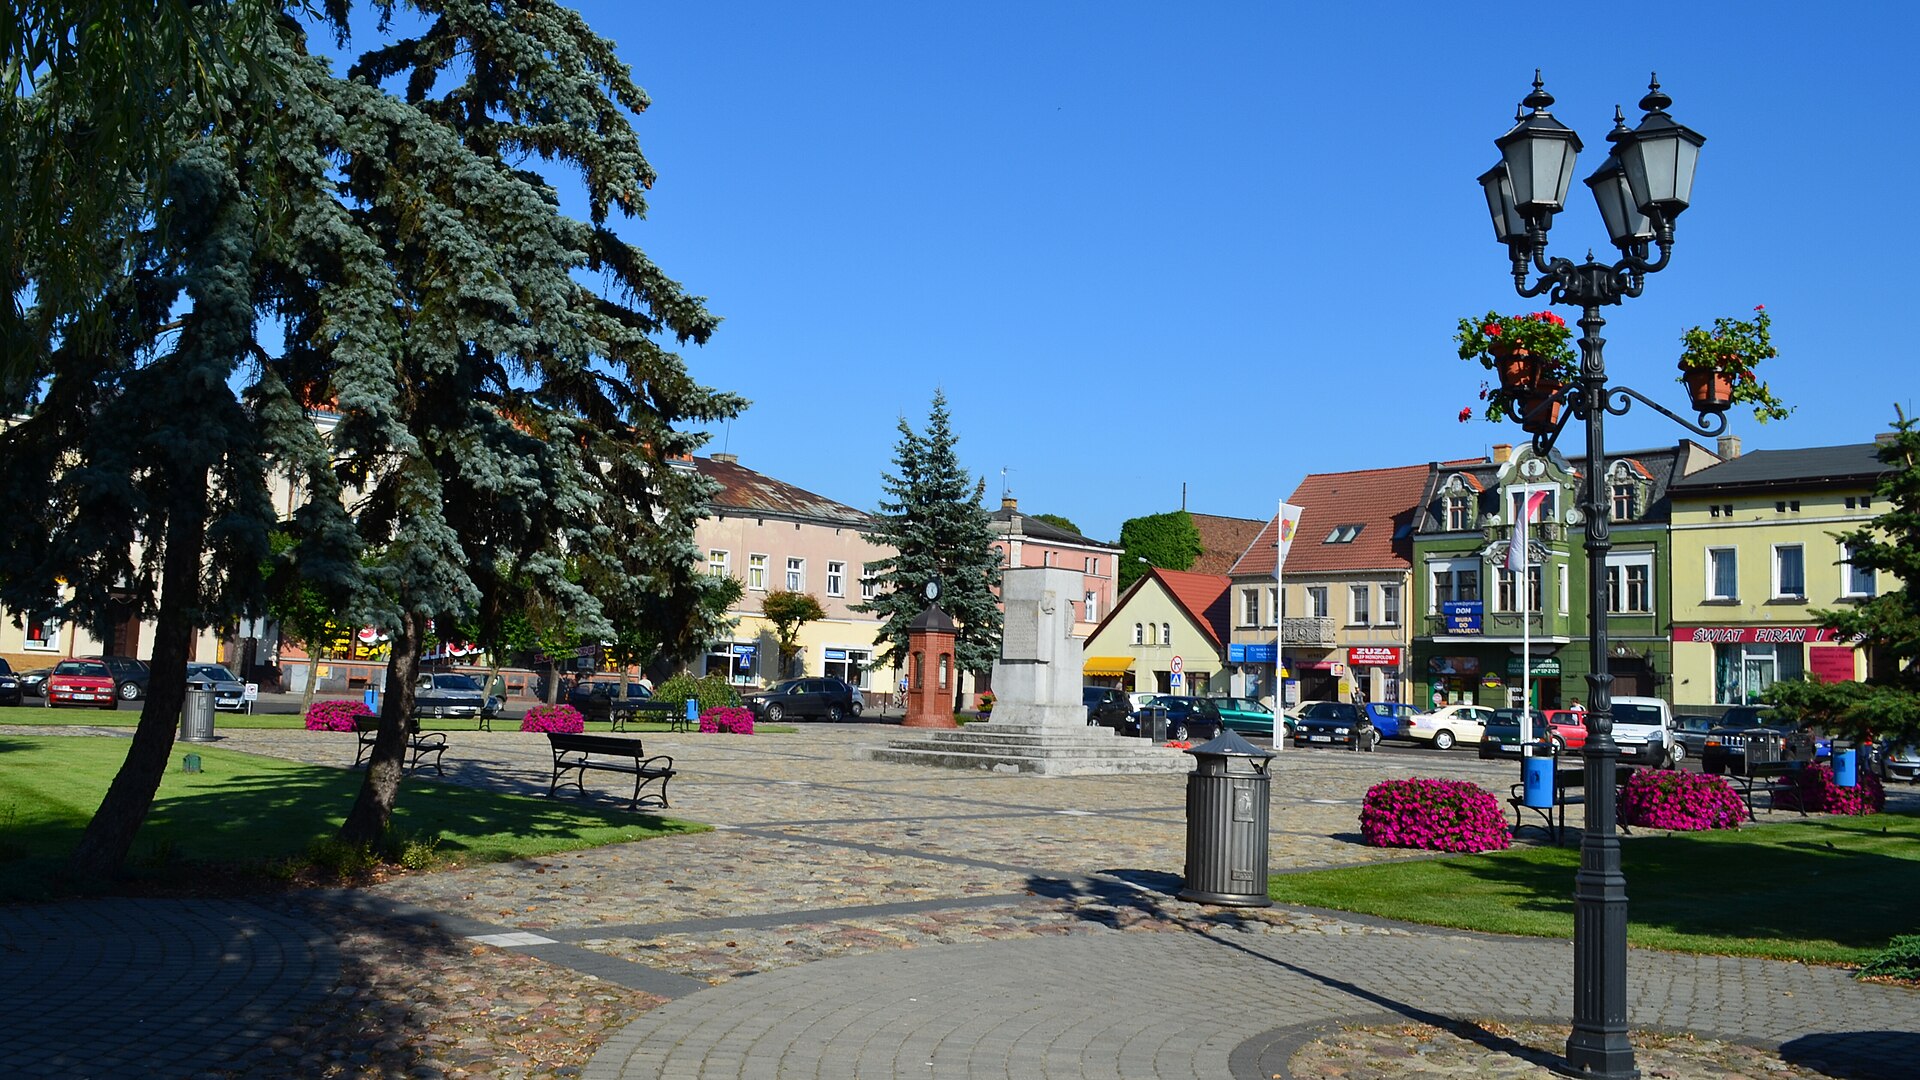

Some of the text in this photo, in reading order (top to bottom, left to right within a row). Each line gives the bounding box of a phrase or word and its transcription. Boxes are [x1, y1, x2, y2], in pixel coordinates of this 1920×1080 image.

[1693, 627, 1744, 642] ŚWIAT
[1755, 628, 1807, 643] FIRAN
[1815, 629, 1824, 642] I
